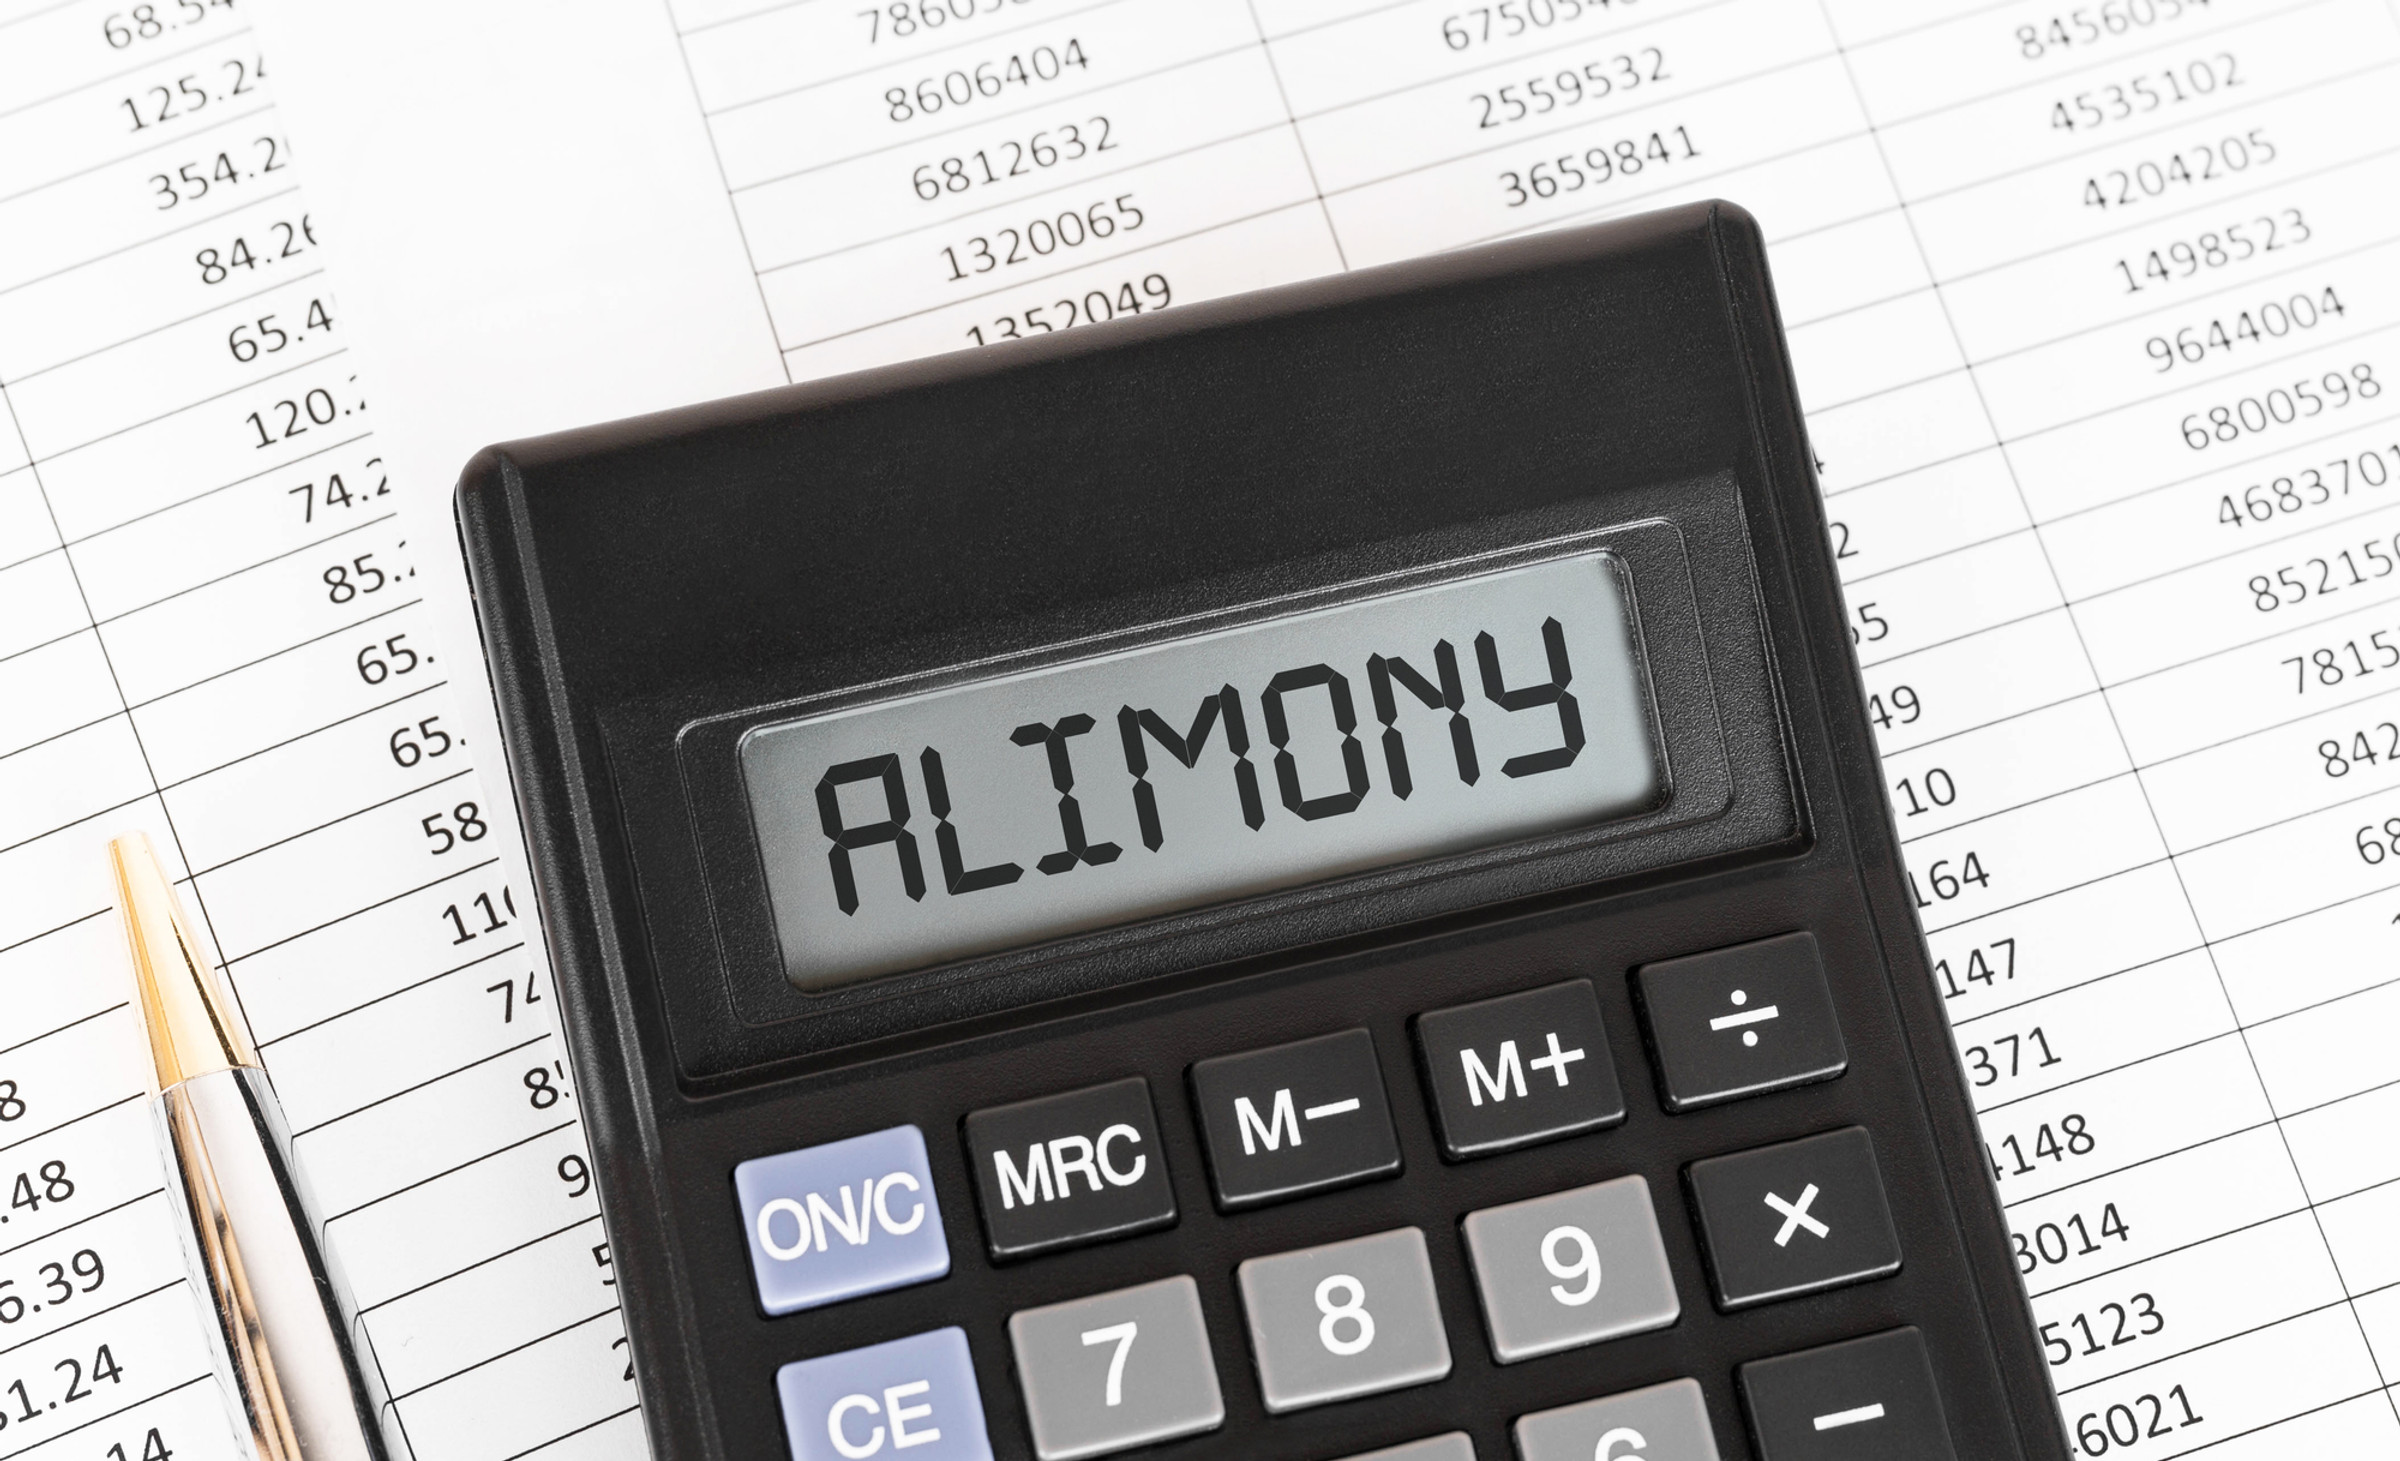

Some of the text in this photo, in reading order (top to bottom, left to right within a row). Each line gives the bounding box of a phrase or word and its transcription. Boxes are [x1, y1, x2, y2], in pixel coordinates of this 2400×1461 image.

[104, 0, 233, 49] 68.5
[857, 0, 1030, 44] 7860
[1442, 0, 1638, 51] 67505
[2015, 0, 2209, 60] 845605
[884, 37, 1090, 123] 8606404
[1470, 46, 1672, 129] 2559532
[2051, 51, 2246, 131] 4535102
[148, 134, 293, 211] 354.2
[912, 115, 1120, 202] 6812632
[1499, 124, 1703, 208] 3659841
[2083, 127, 2278, 210] 4204205
[940, 193, 1145, 283] 1320065
[2114, 207, 2312, 294] 1498523
[2145, 285, 2345, 374] 9644004
[2181, 362, 2381, 451] 6800598
[322, 540, 416, 605] 85.
[2248, 532, 2400, 612] 85215
[1868, 685, 1922, 730] 49
[814, 616, 1586, 917] ALIMONY
[2318, 721, 2400, 778] 842
[420, 800, 489, 856] 58
[1896, 766, 1957, 818] 10
[1934, 937, 2017, 1000] 147
[523, 1059, 571, 1111] 8
[1964, 1026, 2063, 1088] 371
[993, 1123, 1146, 1210] MRC
[756, 1171, 926, 1261] ON/C
[1540, 1225, 1602, 1306] 9
[1315, 1274, 1376, 1355] 8
[2038, 1292, 2165, 1367] 5123
[1081, 1321, 1138, 1406] 7
[827, 1379, 942, 1459] CE
[2072, 1383, 2205, 1458] 6021
